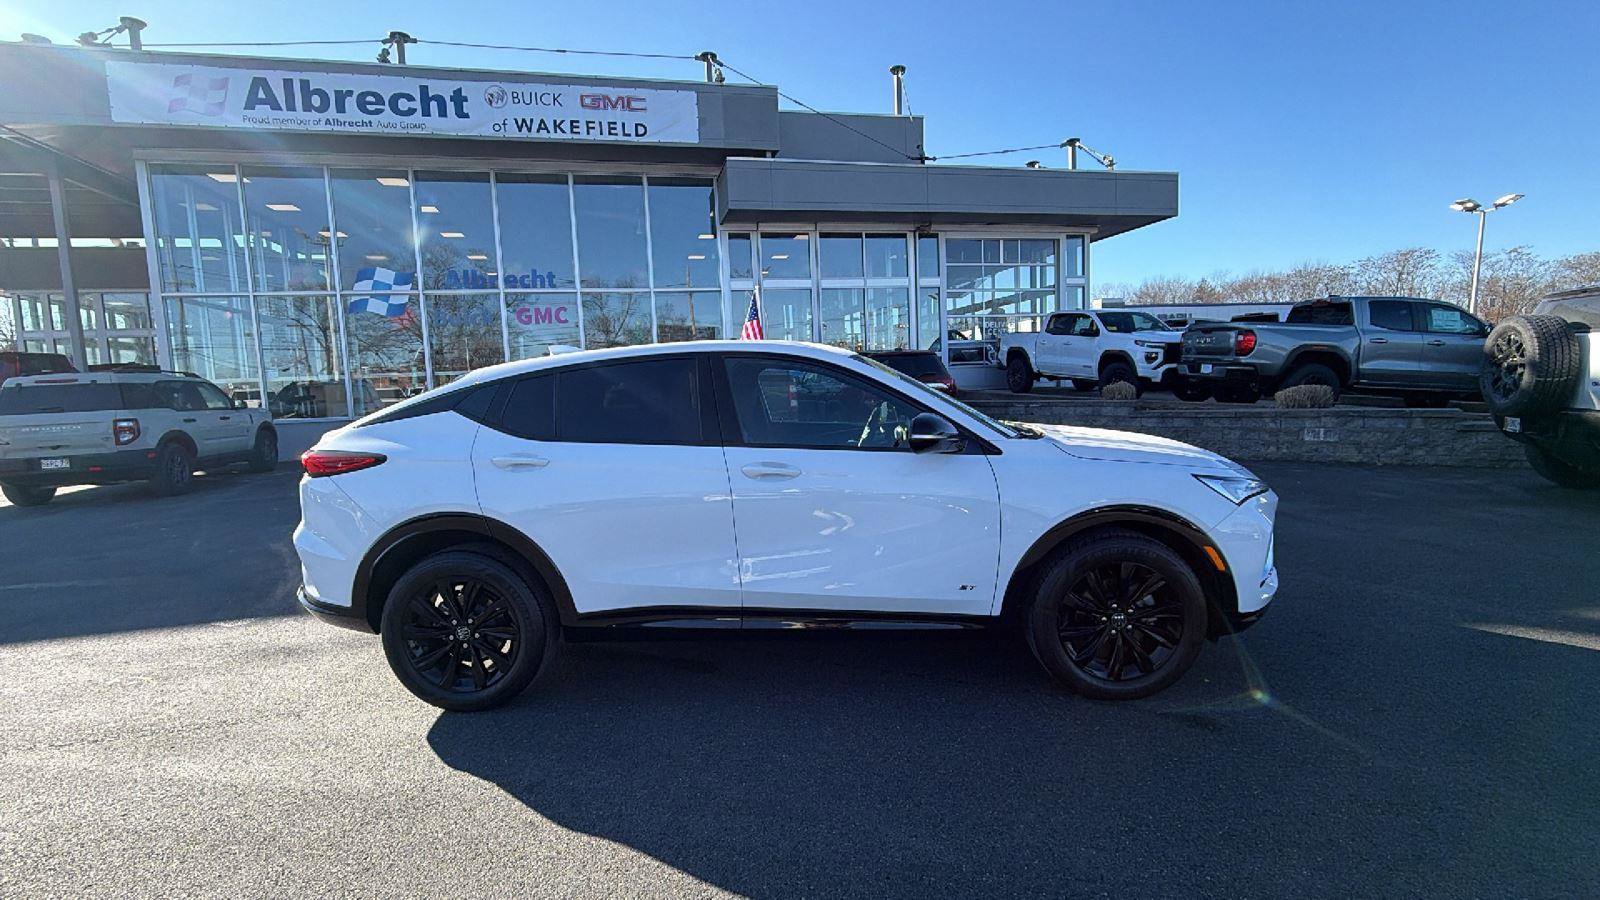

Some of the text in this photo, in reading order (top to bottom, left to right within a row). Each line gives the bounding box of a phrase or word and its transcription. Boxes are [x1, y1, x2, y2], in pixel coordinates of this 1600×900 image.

[243, 76, 470, 119] Albrecht
[512, 91, 648, 112] BUICK GMC
[243, 114, 427, 130] Proud member of Albrecht Auto Group
[492, 117, 648, 138] of WAKEFIELD
[445, 268, 556, 289] Albrecht
[514, 306, 569, 325] GMC
